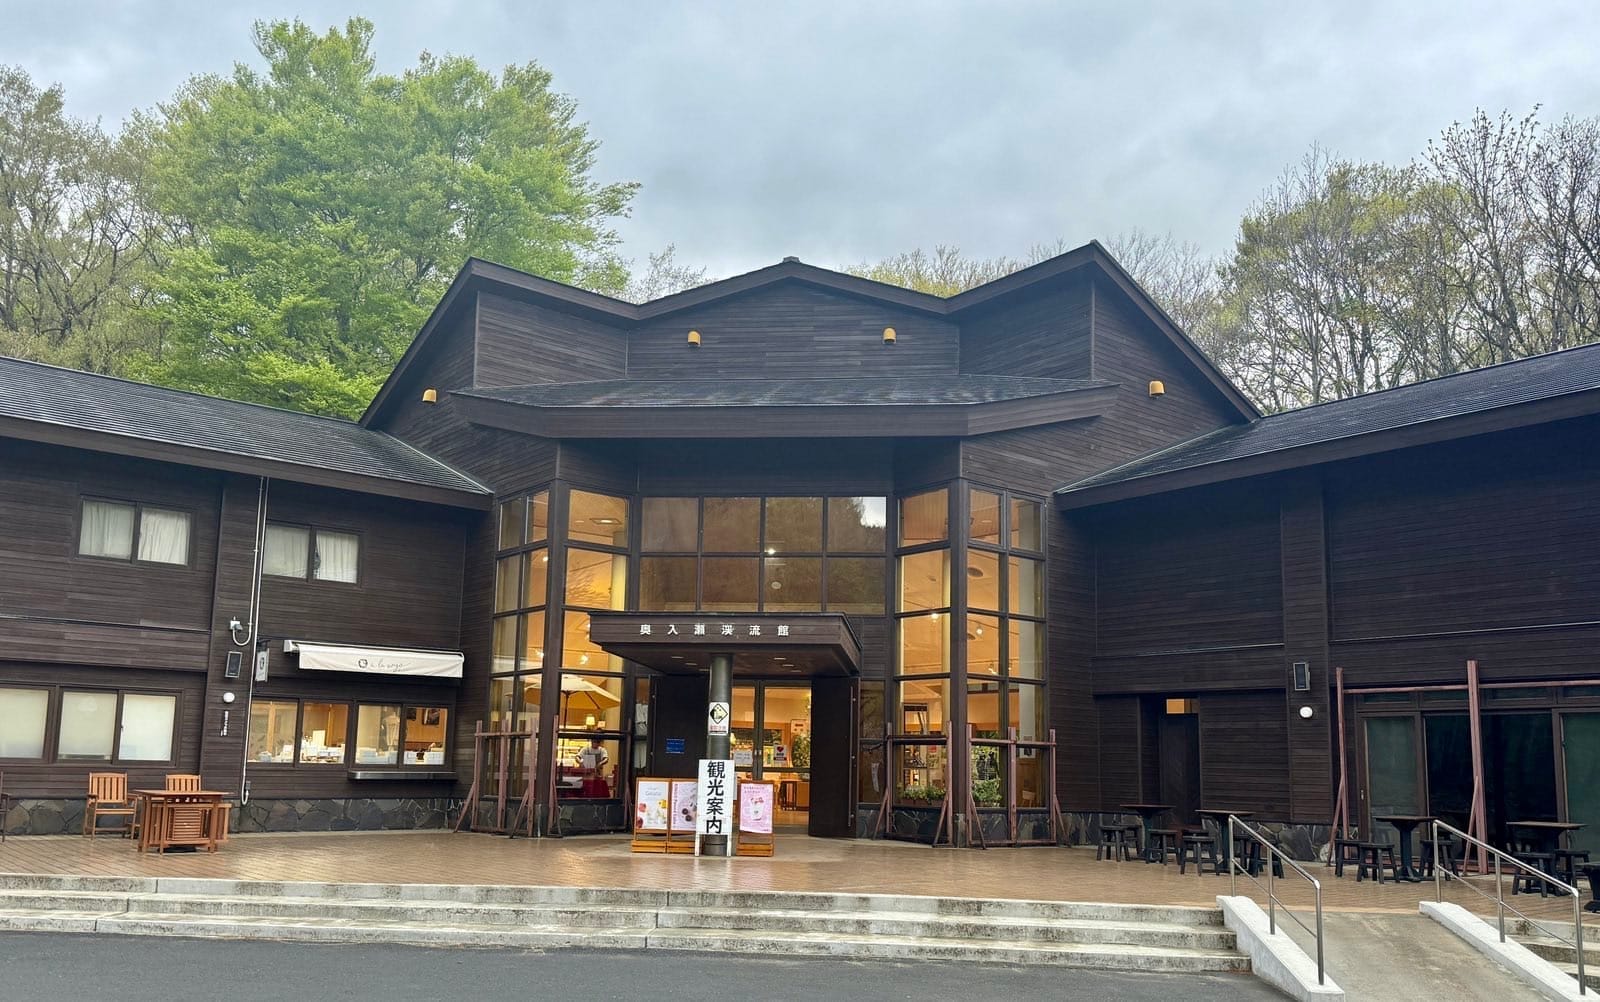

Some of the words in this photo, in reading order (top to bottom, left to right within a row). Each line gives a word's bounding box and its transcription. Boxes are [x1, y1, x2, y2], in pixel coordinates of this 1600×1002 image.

[640, 624, 789, 637] 奥入瀬渓流館
[706, 761, 725, 834] 観光案内
